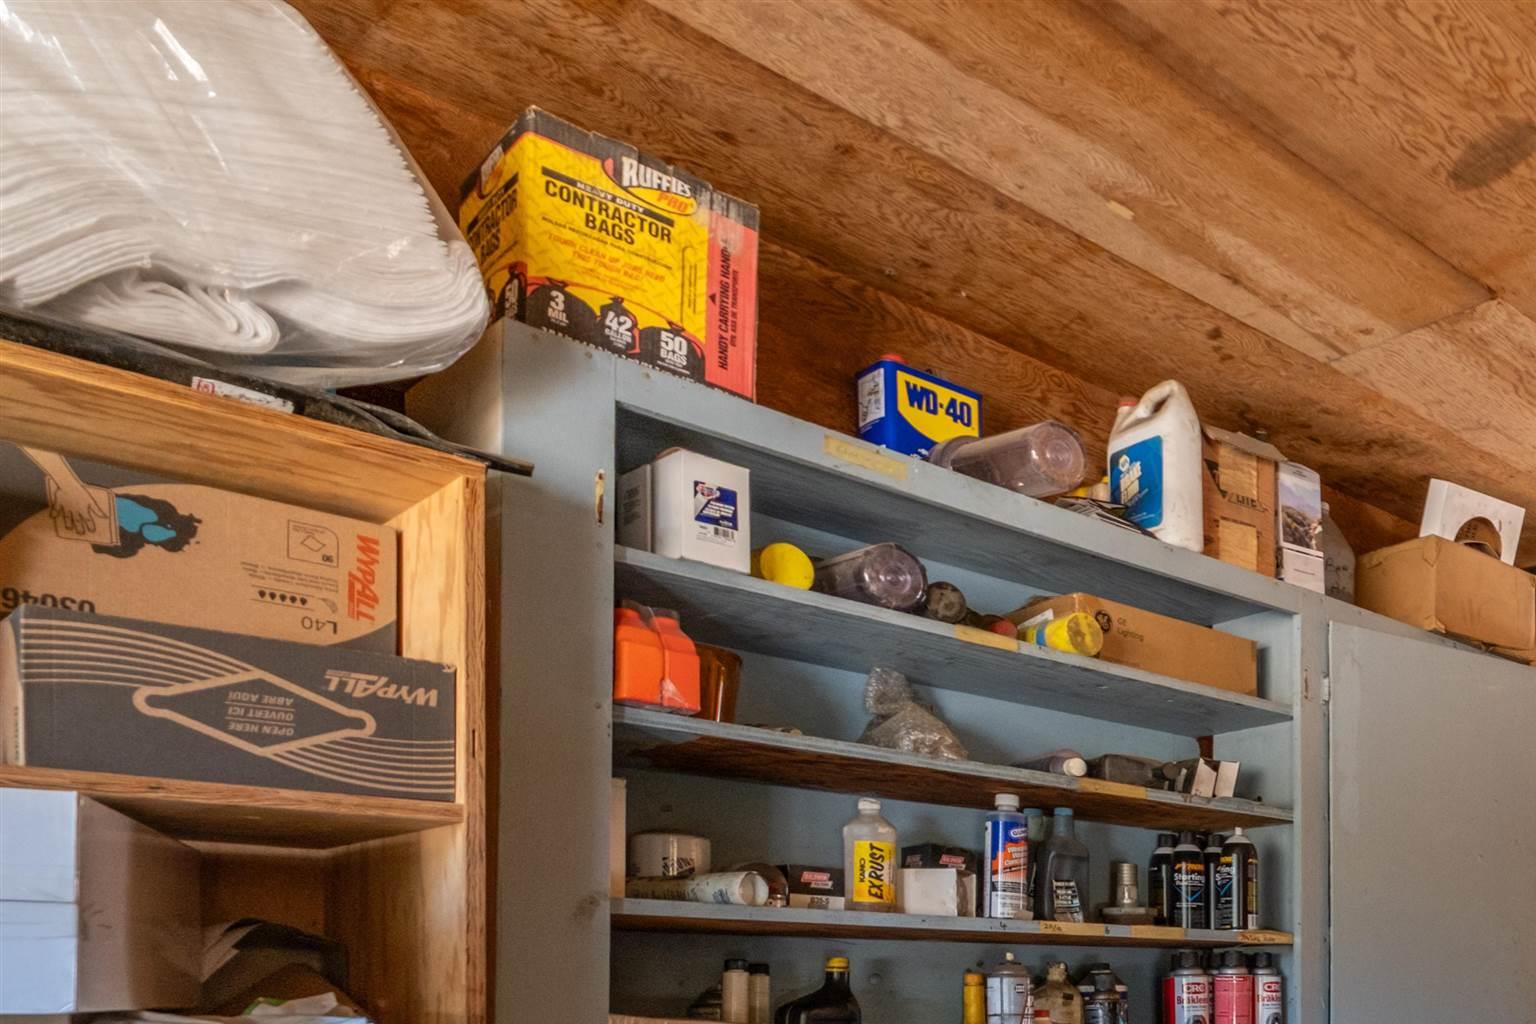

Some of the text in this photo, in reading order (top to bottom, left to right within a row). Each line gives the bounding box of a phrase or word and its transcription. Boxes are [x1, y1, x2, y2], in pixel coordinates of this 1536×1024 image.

[621, 156, 692, 198] RUFFIES
[544, 179, 672, 244] CONTRACTOR
[614, 196, 646, 213] DUTY
[656, 190, 691, 213] PRO
[585, 213, 636, 246] BAGS
[550, 290, 565, 311] 3
[718, 279, 730, 333] CARRYING
[547, 307, 569, 323] MIL
[605, 311, 633, 337] 42
[660, 330, 688, 356] 50
[718, 335, 729, 371] HANDY
[660, 349, 688, 366] BAGS
[904, 379, 972, 428] WD-40
[347, 533, 381, 622] WYPALL
[301, 616, 338, 635] L40
[227, 691, 294, 706] ABRE AQUI
[323, 669, 439, 707] WYPALL
[227, 707, 294, 721] OUVERT ICI
[227, 721, 295, 737] OPEN HERE
